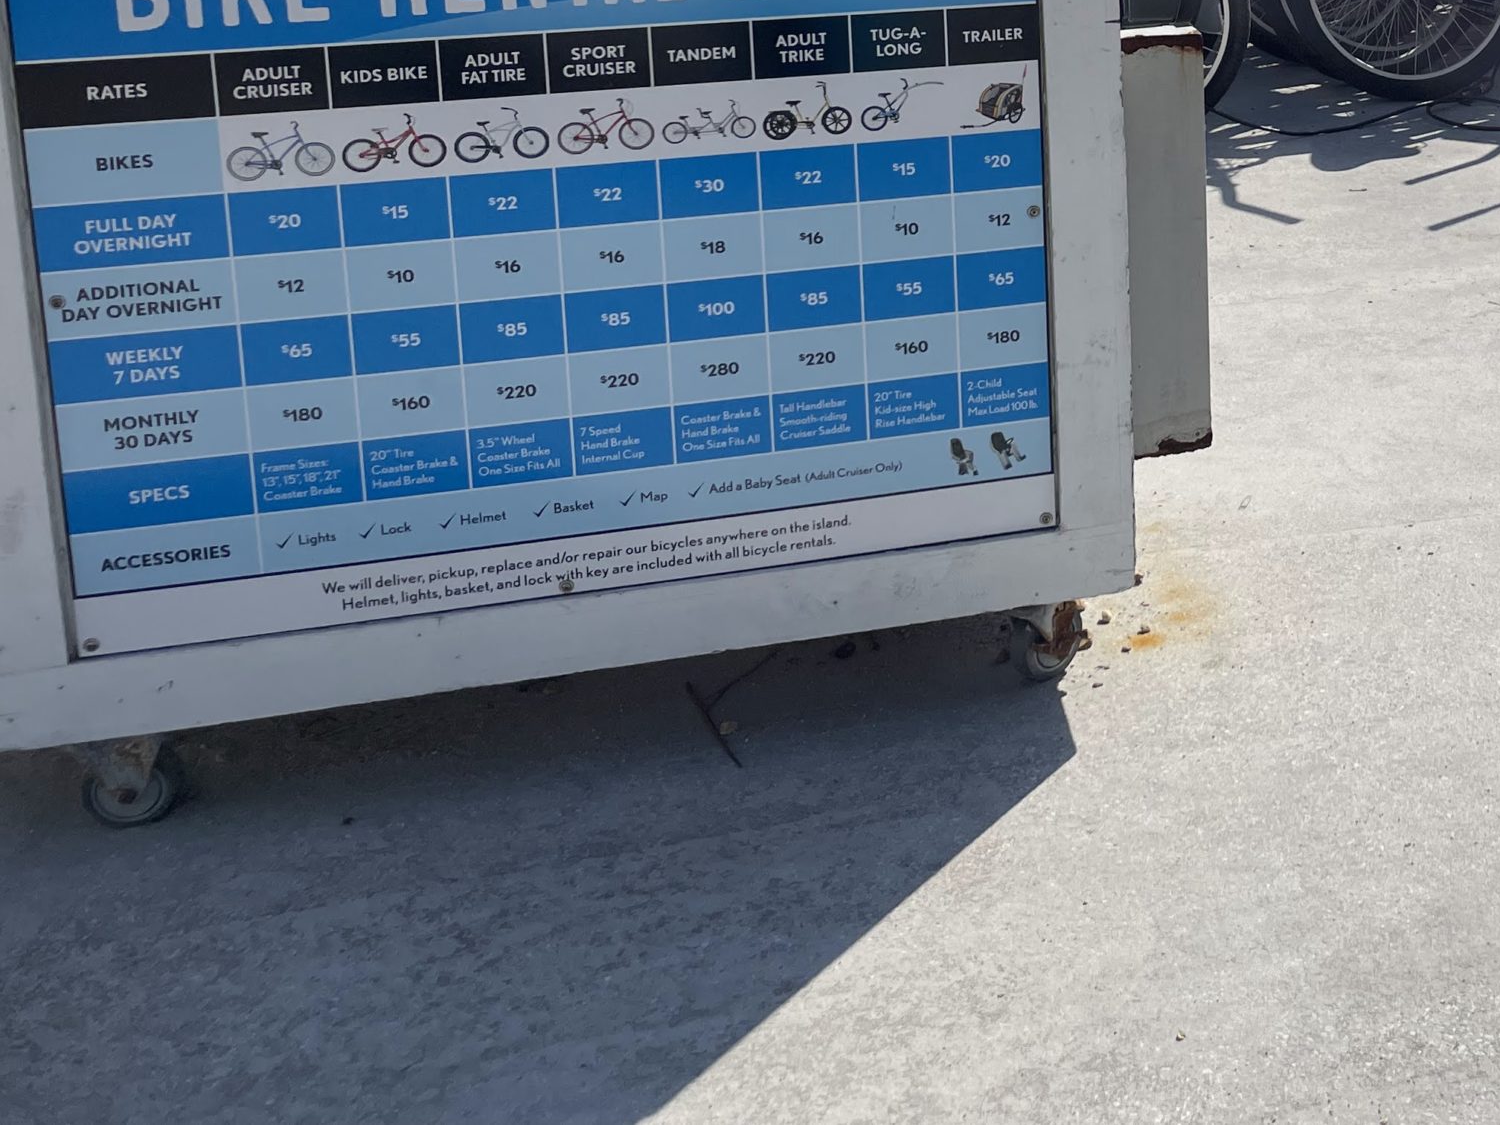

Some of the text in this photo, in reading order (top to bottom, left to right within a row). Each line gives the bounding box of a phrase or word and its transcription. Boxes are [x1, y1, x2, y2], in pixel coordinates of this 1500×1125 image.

[774, 30, 828, 48] ADULT
[868, 25, 927, 42] TUG-A-
[961, 26, 1023, 44] TRAILER
[569, 43, 627, 61] SPORT
[665, 45, 737, 63] TANDEM
[778, 47, 825, 64] TRIKE
[875, 41, 923, 58] LONG
[463, 50, 521, 68] ADULT
[240, 64, 301, 83] ADULT
[339, 64, 428, 85] KIDS BIKE
[460, 66, 527, 85] FAT TIRE
[561, 59, 637, 79] CRUISER
[85, 82, 148, 101] RATES
[232, 81, 313, 100] CRUISER
[94, 153, 154, 172] BIKES
[891, 161, 917, 177] $15
[983, 153, 1012, 169] $20
[693, 177, 725, 194] $30
[793, 169, 823, 185] $22
[487, 194, 519, 211] $22
[592, 186, 623, 202] $22
[381, 203, 409, 220] $15
[987, 212, 1012, 227] $12
[83, 212, 177, 235] FULL DAY
[267, 212, 302, 230] $20
[894, 221, 920, 237] $10
[72, 230, 192, 255] OVERNIGHT
[699, 239, 727, 255] $18
[798, 230, 825, 246] $16
[598, 249, 626, 264] $16
[493, 258, 522, 274] $16
[385, 268, 415, 284] $10
[987, 270, 1015, 287] $65
[75, 277, 201, 303] ADDITIONAL
[276, 277, 305, 294] $12
[895, 280, 923, 297] $55
[799, 290, 829, 307] $85
[60, 294, 223, 324] DAY OVERNIGHT
[697, 300, 736, 317] $100
[599, 310, 631, 327] $85
[496, 321, 528, 338] $85
[986, 328, 1021, 345] $180
[390, 331, 422, 348] $55
[893, 339, 929, 356] $160
[104, 344, 184, 367] WEEKLY
[280, 342, 313, 359] $65
[797, 349, 837, 367] $220
[112, 364, 181, 386] 7 DAYS
[699, 360, 740, 378] $280
[599, 371, 640, 389] $220
[965, 376, 1003, 392] 2-Child
[495, 383, 538, 400] $220
[893, 389, 913, 400] Tire
[966, 386, 1038, 405] Adjustable Seat
[390, 394, 431, 412] $160
[873, 398, 938, 416] Kid-size High
[102, 408, 200, 433] MONTHLY
[281, 405, 324, 423] $180
[679, 405, 762, 426] Coaster Brake &
[874, 411, 946, 429] Rise Handlebar
[578, 422, 622, 438] 7 Speed
[680, 422, 740, 440] Hand Brake
[113, 428, 194, 451] 30 DAYS
[499, 432, 536, 447] Wheel
[579, 434, 641, 451] Hand Brake
[681, 433, 761, 453] One Size Fits All
[392, 447, 415, 459] Tire
[476, 445, 551, 463] Coaster Brake
[580, 448, 646, 465] Internal Cup
[370, 454, 459, 476] Coaster Brake &
[477, 456, 561, 477] One Size Fits All
[371, 472, 436, 490] Hand Brake
[707, 460, 903, 495] Add a Baby Seat (Adult Cruiser Only)
[127, 483, 191, 505] SPECS
[262, 483, 343, 502] Coaster Brake
[639, 490, 669, 504] Map
[552, 499, 595, 515] Basket
[459, 510, 507, 526] Helmet
[379, 520, 413, 536] Lock
[296, 531, 337, 548] Lights
[100, 543, 231, 573] ACCESSORIES
[320, 513, 852, 595] We will deliver, pickup, replace and/or repair our bicycles anywhere on the island.
[341, 533, 836, 611] Helmet, lights, basket, and lock with key are included with all bicycle rentals.
